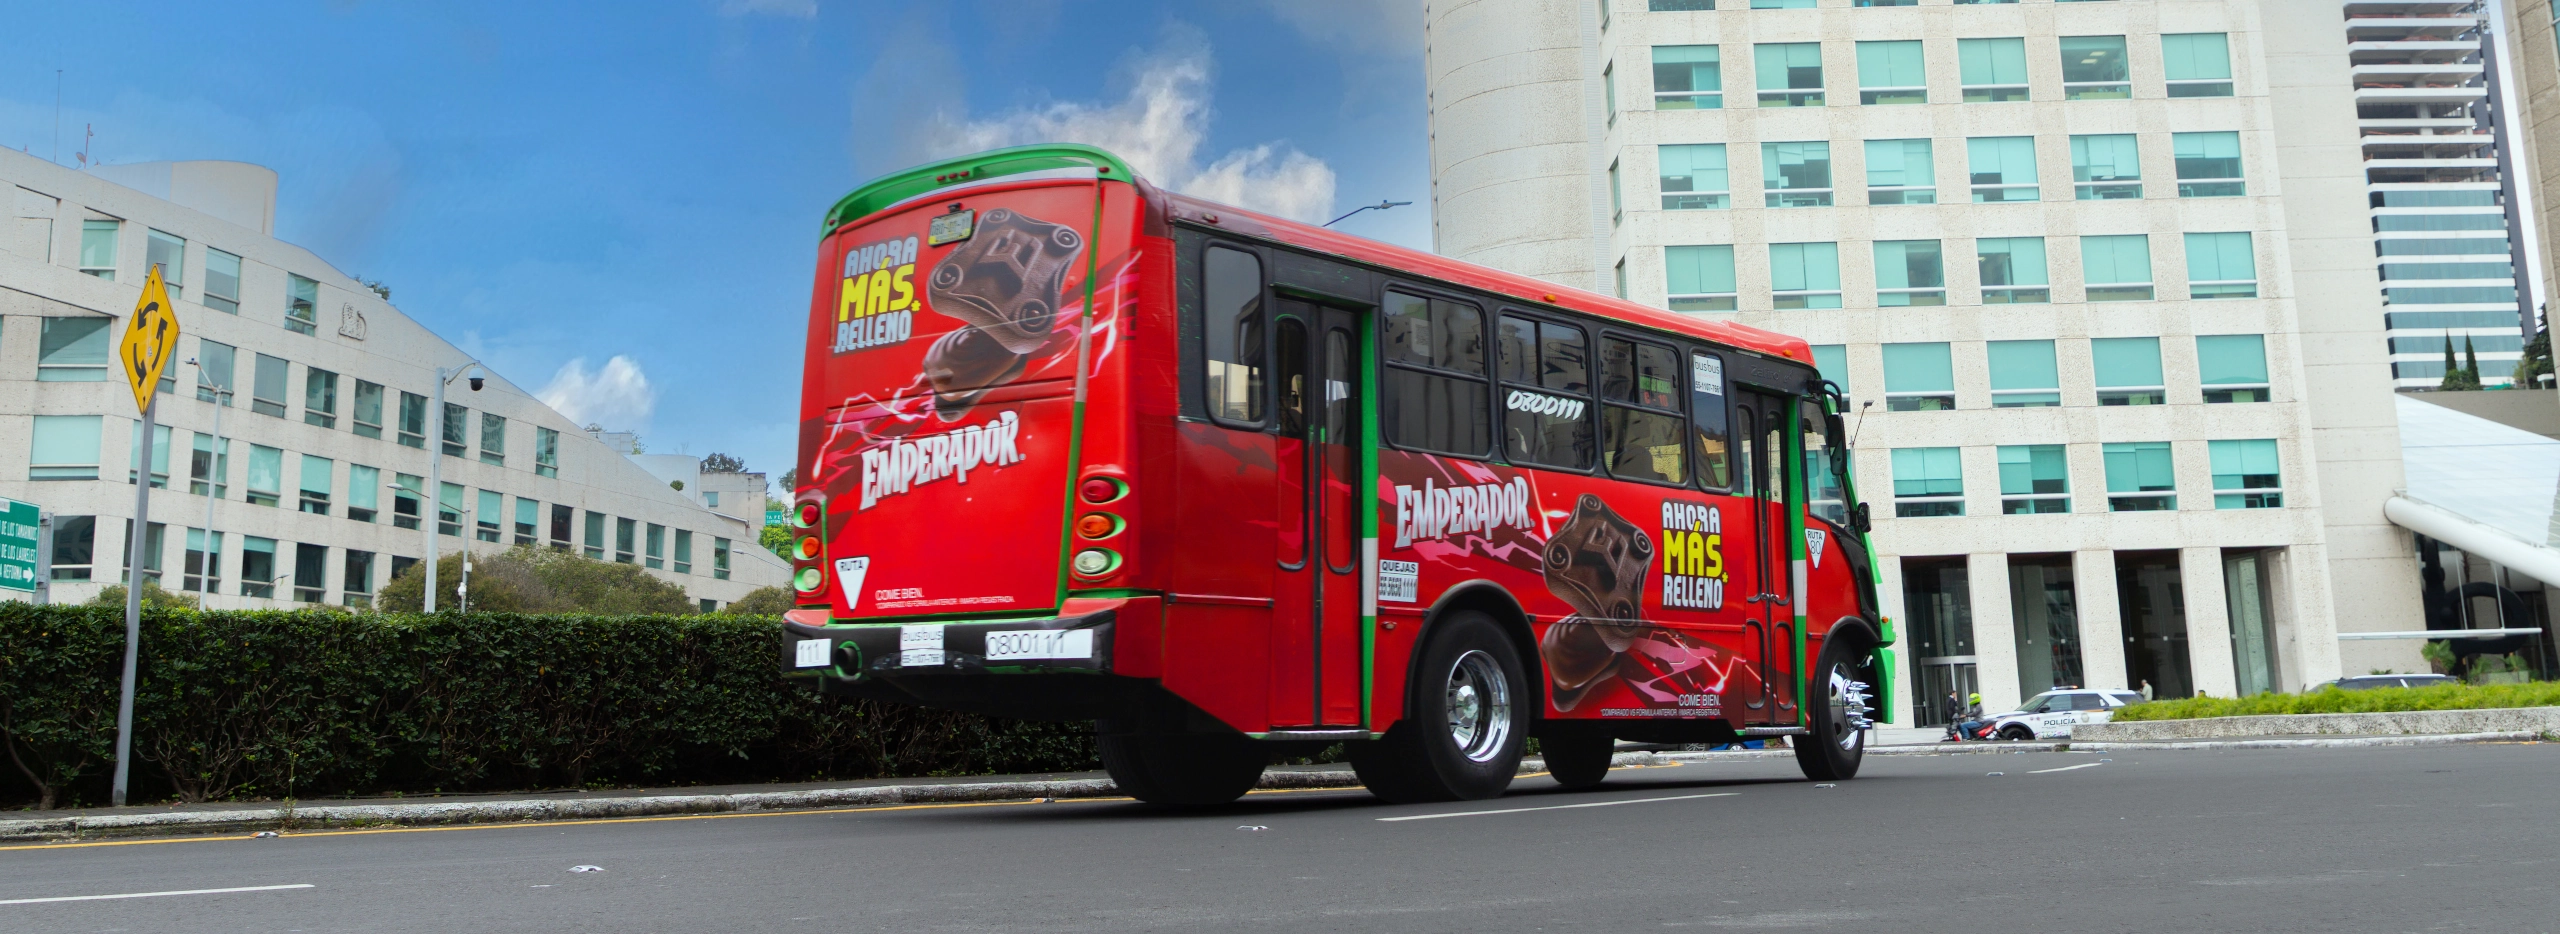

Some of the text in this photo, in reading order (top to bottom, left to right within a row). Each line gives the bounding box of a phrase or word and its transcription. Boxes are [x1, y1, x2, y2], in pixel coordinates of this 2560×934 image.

[844, 236, 918, 278] AHORA
[834, 309, 912, 353] RELLENO
[1507, 390, 1584, 420] 0800111
[859, 410, 1021, 511] EMPERADOR
[1395, 476, 1531, 548] EMPERADOR
[1662, 502, 1720, 533] AHORA
[1808, 531, 1822, 540] RUTA
[1811, 540, 1821, 554] 80
[841, 560, 864, 571] RUTA
[1382, 561, 1416, 574] QUEJAS
[875, 588, 900, 600] COME
[1663, 575, 1722, 609] RELLENO
[800, 643, 820, 662] 111
[1678, 694, 1701, 706] COME
[2044, 716, 2076, 726] POLICÍA
